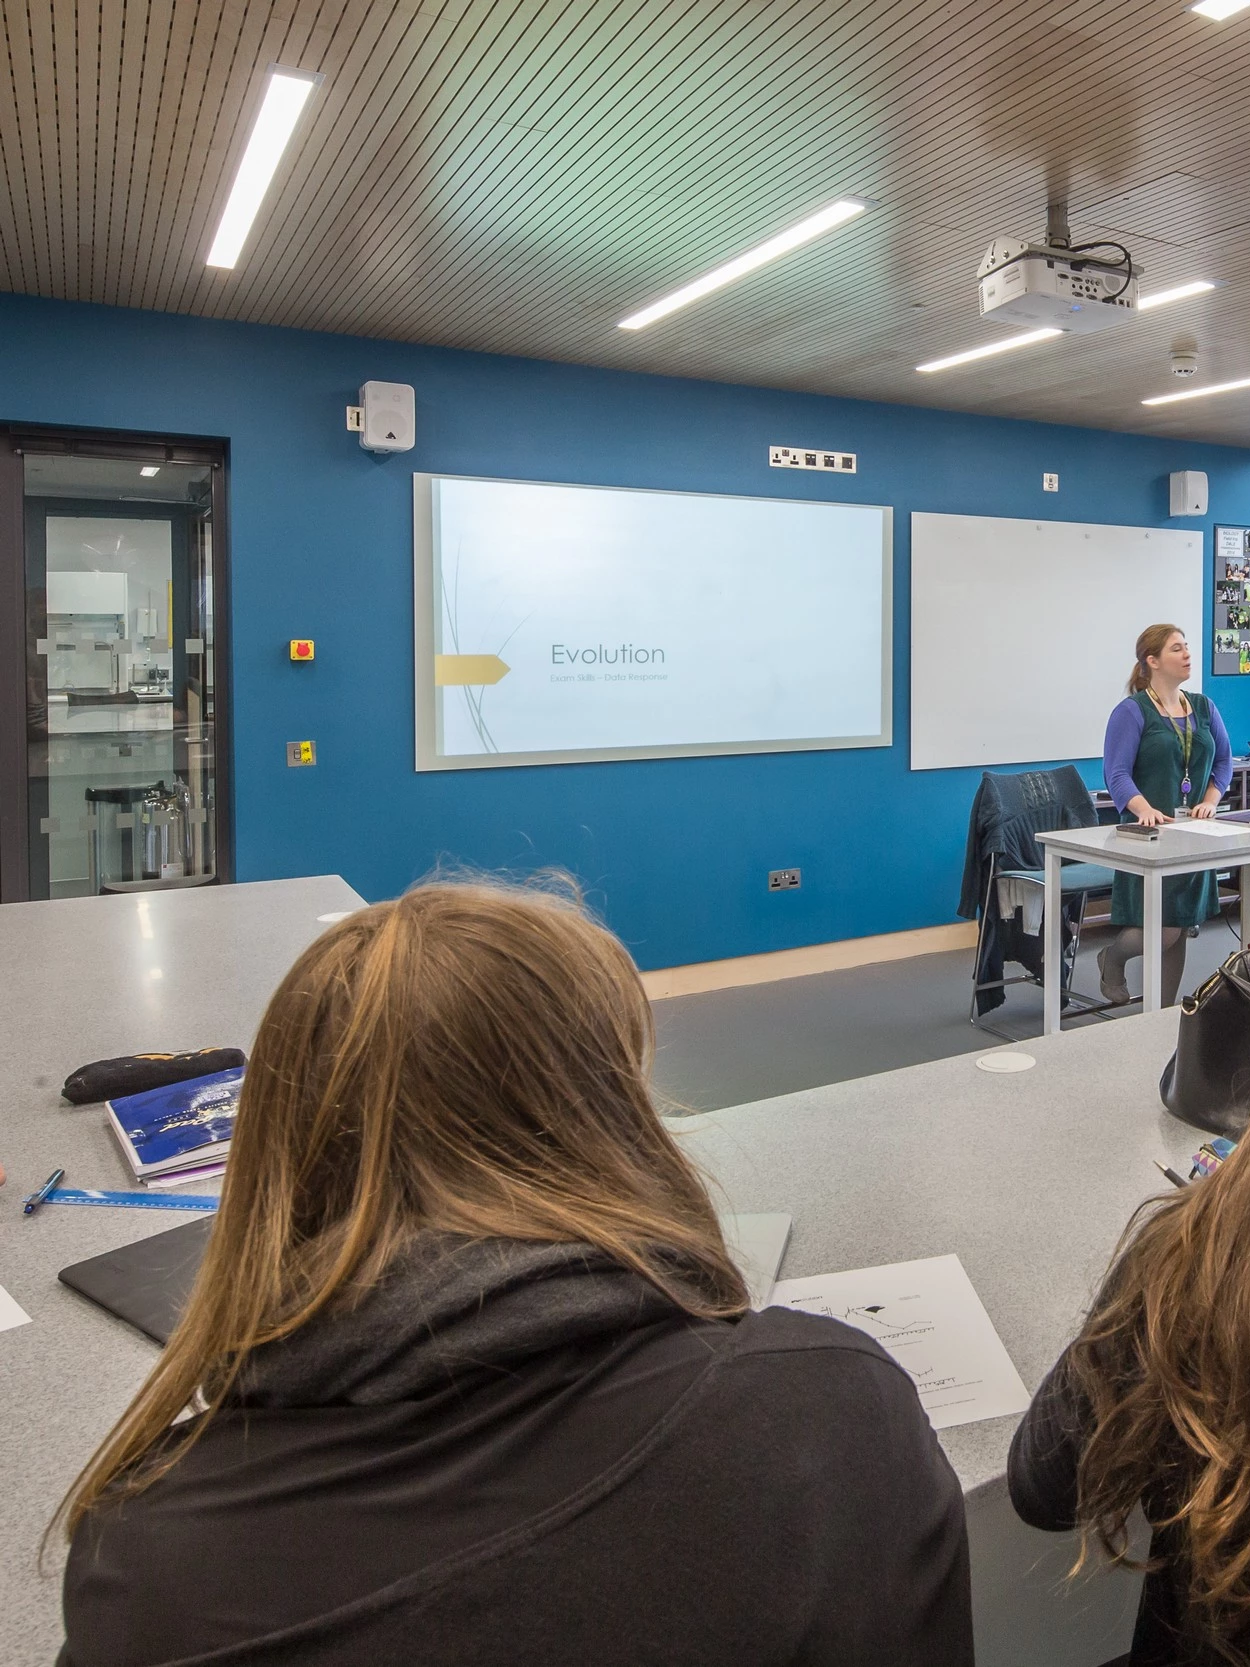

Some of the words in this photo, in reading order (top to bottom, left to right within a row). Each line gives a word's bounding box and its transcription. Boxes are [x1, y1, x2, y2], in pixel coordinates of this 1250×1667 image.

[551, 643, 665, 665] Evolution
[550, 674, 575, 682] Exam
[577, 673, 596, 682] Skills
[604, 673, 626, 681] Data
[628, 673, 668, 682] Response
